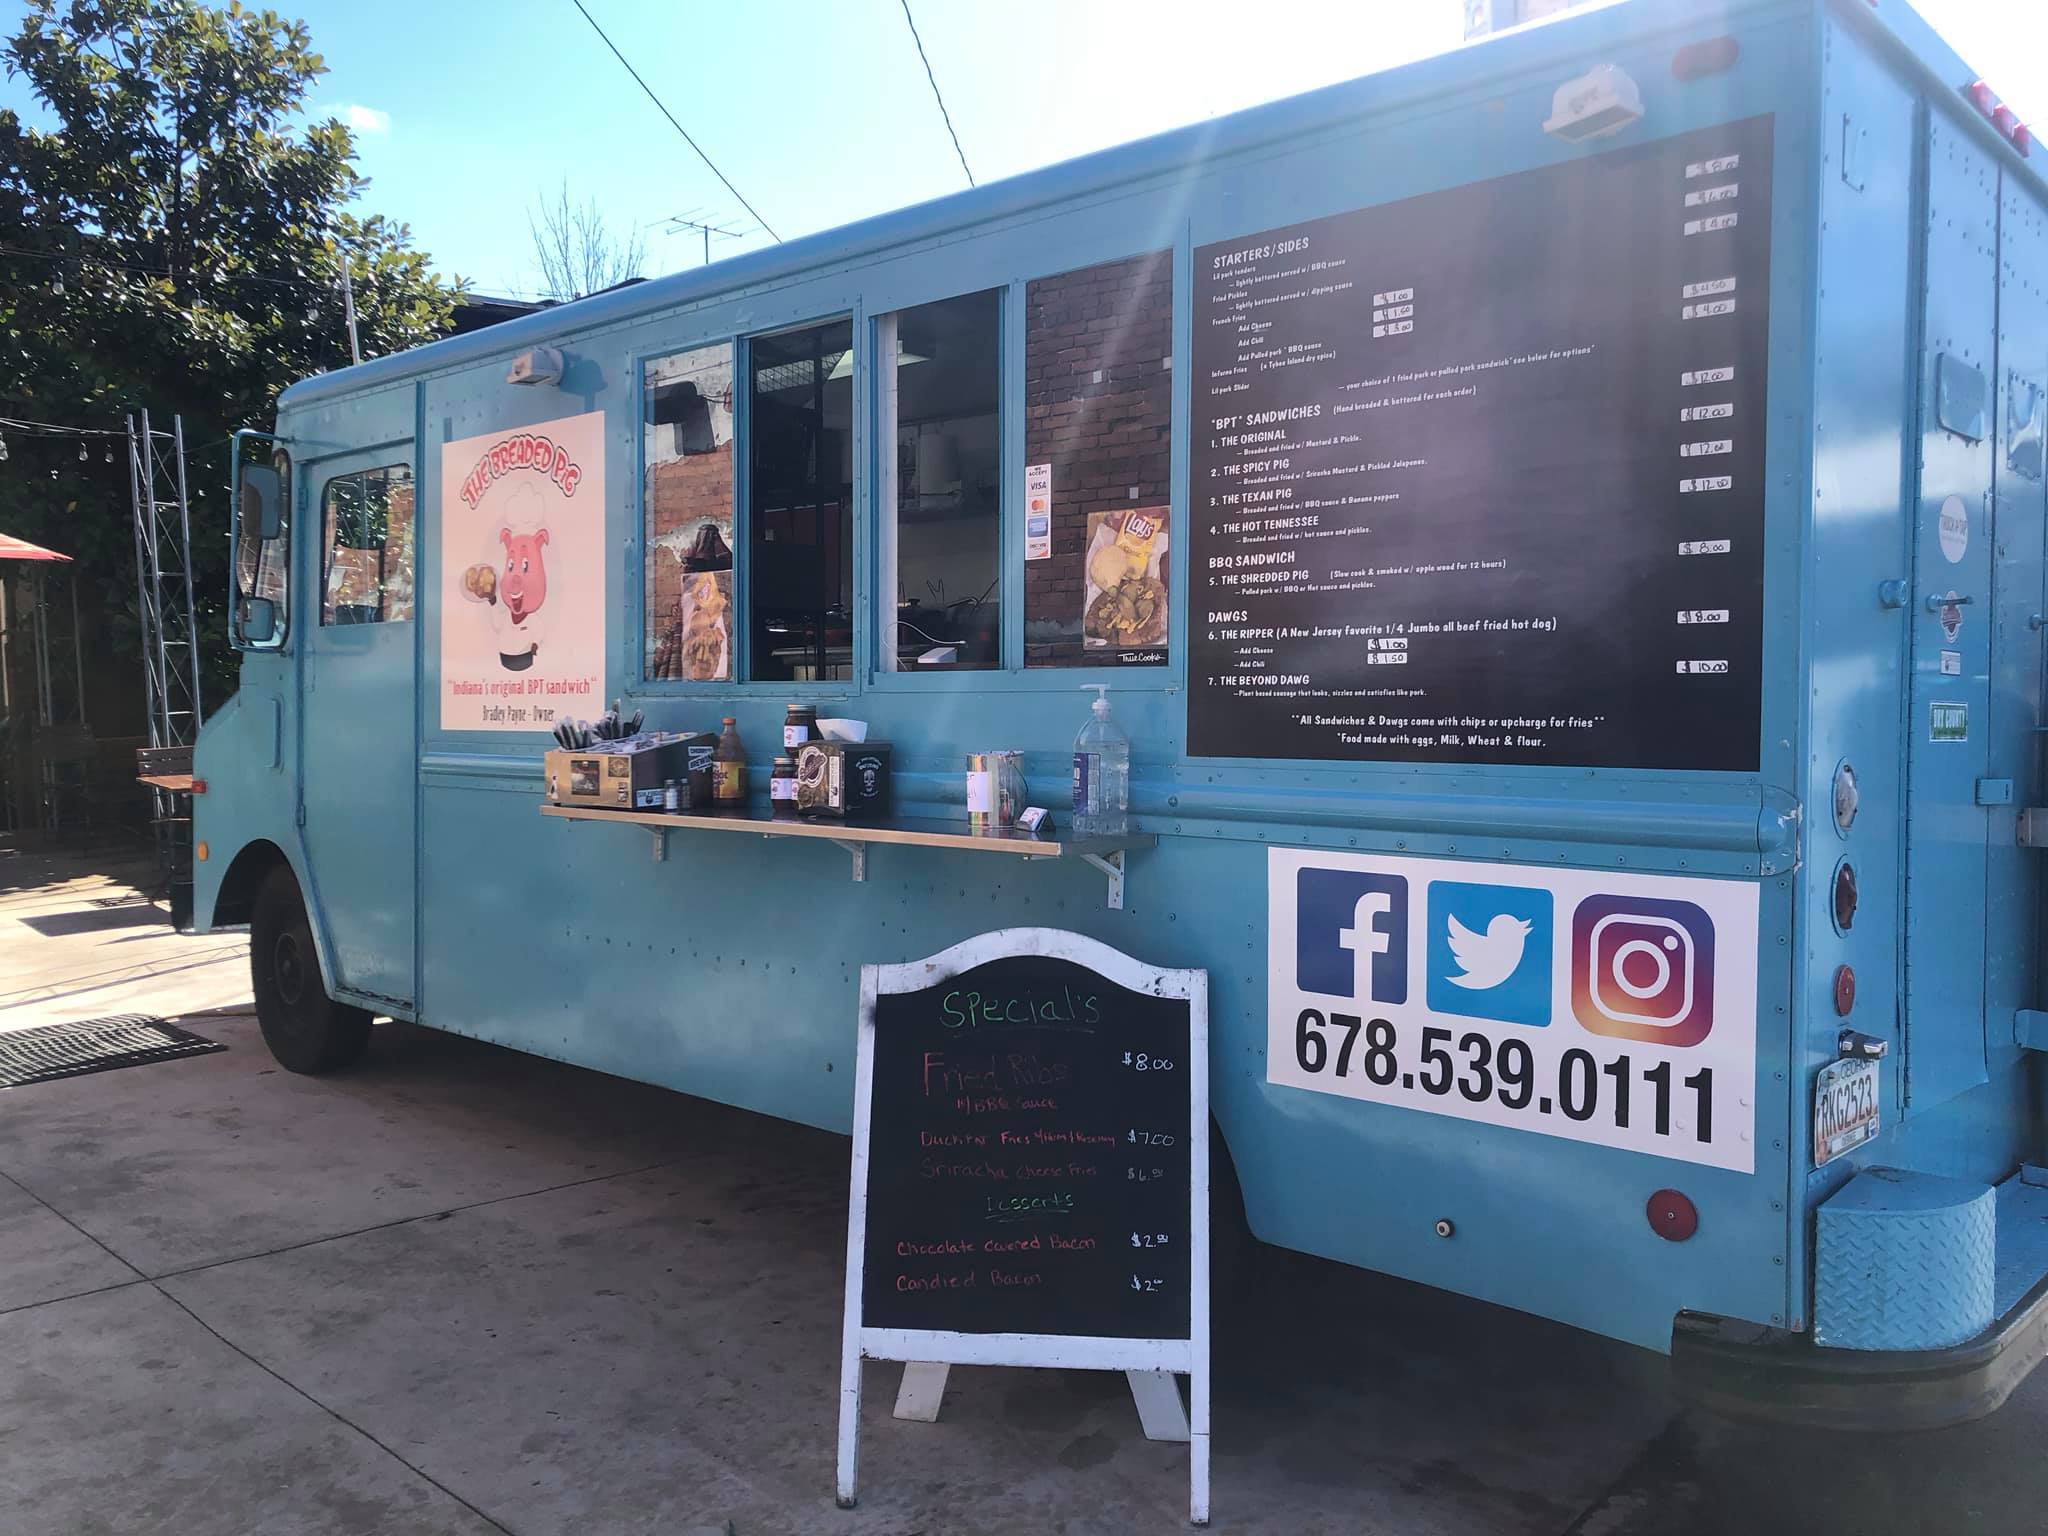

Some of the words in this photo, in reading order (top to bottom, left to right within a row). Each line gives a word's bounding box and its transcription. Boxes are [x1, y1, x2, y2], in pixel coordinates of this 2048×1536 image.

[1213, 236, 1310, 270] STARTERS/SIDES
[1246, 404, 1321, 426] SANDWICHES
[1211, 438, 1219, 448] 1.
[1221, 435, 1239, 447] THE
[1241, 429, 1287, 445] ORIGINAL
[463, 460, 490, 504] THE
[490, 439, 553, 475] BREADED
[1210, 468, 1221, 477] 2.
[1223, 465, 1241, 476] THE
[1242, 460, 1271, 474] SPICY
[1273, 458, 1290, 469] PIG
[1030, 480, 1047, 491] VISA
[1209, 496, 1220, 507] 3.
[1222, 494, 1240, 505] THE
[1241, 490, 1274, 504] TEXAN
[1275, 487, 1292, 500] PIG
[1209, 524, 1220, 535] 4.
[1223, 523, 1241, 534] THE
[1242, 520, 1262, 532] HOT
[1263, 515, 1320, 530] TENNESSEE
[1208, 556, 1233, 570] BBQ
[1235, 551, 1296, 567] SANDWICH
[1208, 575, 1219, 586] 5.
[1221, 573, 1239, 585] THE
[1241, 570, 1290, 584] SHREDDED
[1292, 569, 1309, 582] PIG
[1208, 610, 1248, 624] DAWGS
[1208, 630, 1218, 641] 6.
[1221, 629, 1238, 640] THE
[1240, 627, 1274, 639] RIPPER
[1276, 627, 1288, 641] (A
[1290, 626, 1309, 638] New
[1312, 624, 1343, 639] Jersey
[1385, 623, 1404, 635] 1/4
[1407, 620, 1440, 634] Jumbo
[1442, 621, 1454, 632] all
[1456, 619, 1481, 632] beef
[1483, 619, 1509, 631] fried
[1511, 619, 1529, 630] hot
[1531, 616, 1557, 632] dog)
[490, 679, 525, 698] original
[527, 679, 544, 695] BPT
[1208, 677, 1217, 686] 7.
[1220, 675, 1237, 686] THE
[1239, 675, 1278, 686] BEYOND
[1280, 675, 1310, 685] DAWG
[1314, 714, 1365, 726] Sandwiches
[1368, 716, 1376, 726] &
[1378, 716, 1409, 728] Dawgs
[1410, 717, 1435, 726] come
[1437, 716, 1458, 727] with
[1460, 716, 1486, 728] chips
[1488, 718, 1499, 727] or
[1501, 717, 1547, 730] upcharge
[1550, 716, 1566, 728] for
[1364, 732, 1387, 744] made
[1389, 733, 1410, 744] with
[1411, 736, 1438, 747] eggs,
[1440, 734, 1465, 746] Milk,
[1467, 735, 1500, 746] Wheat
[1504, 735, 1513, 746] &
[1517, 735, 1546, 747] flour.
[1295, 1007, 1714, 1144] 678.539.0111
[895, 1271, 976, 1293] Candied
[990, 1269, 1043, 1286] Bacon
